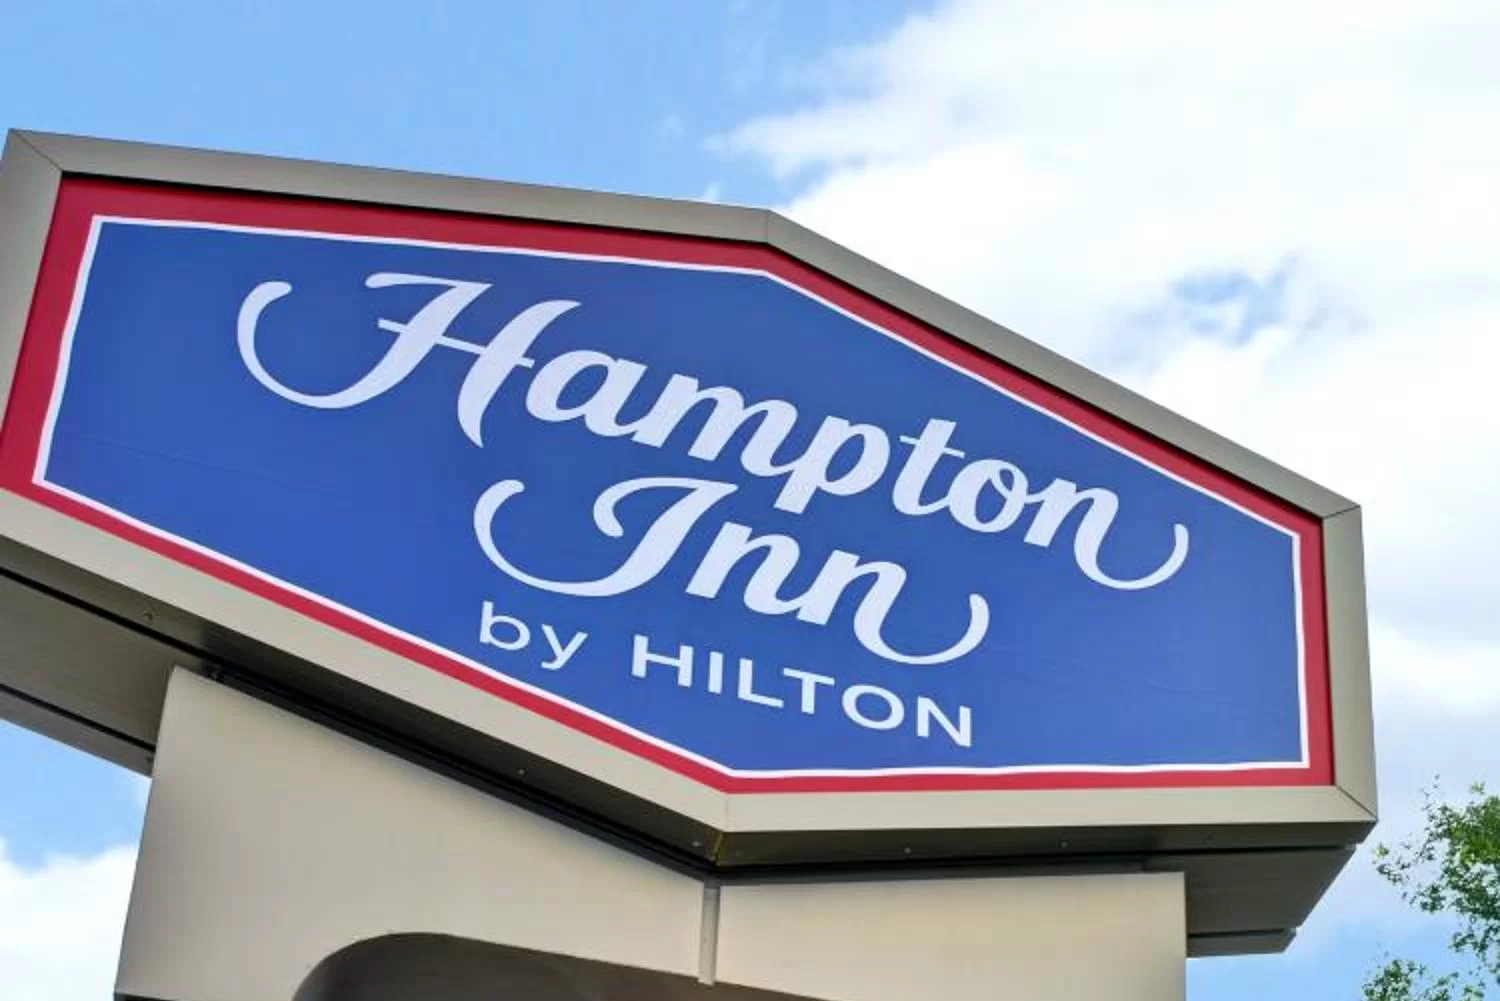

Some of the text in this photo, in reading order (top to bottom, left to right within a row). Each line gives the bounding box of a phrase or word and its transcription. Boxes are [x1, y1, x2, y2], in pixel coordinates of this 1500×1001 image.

[236, 272, 1190, 591] Hampton
[472, 476, 990, 666] Inn
[478, 600, 973, 748] by HILTON
